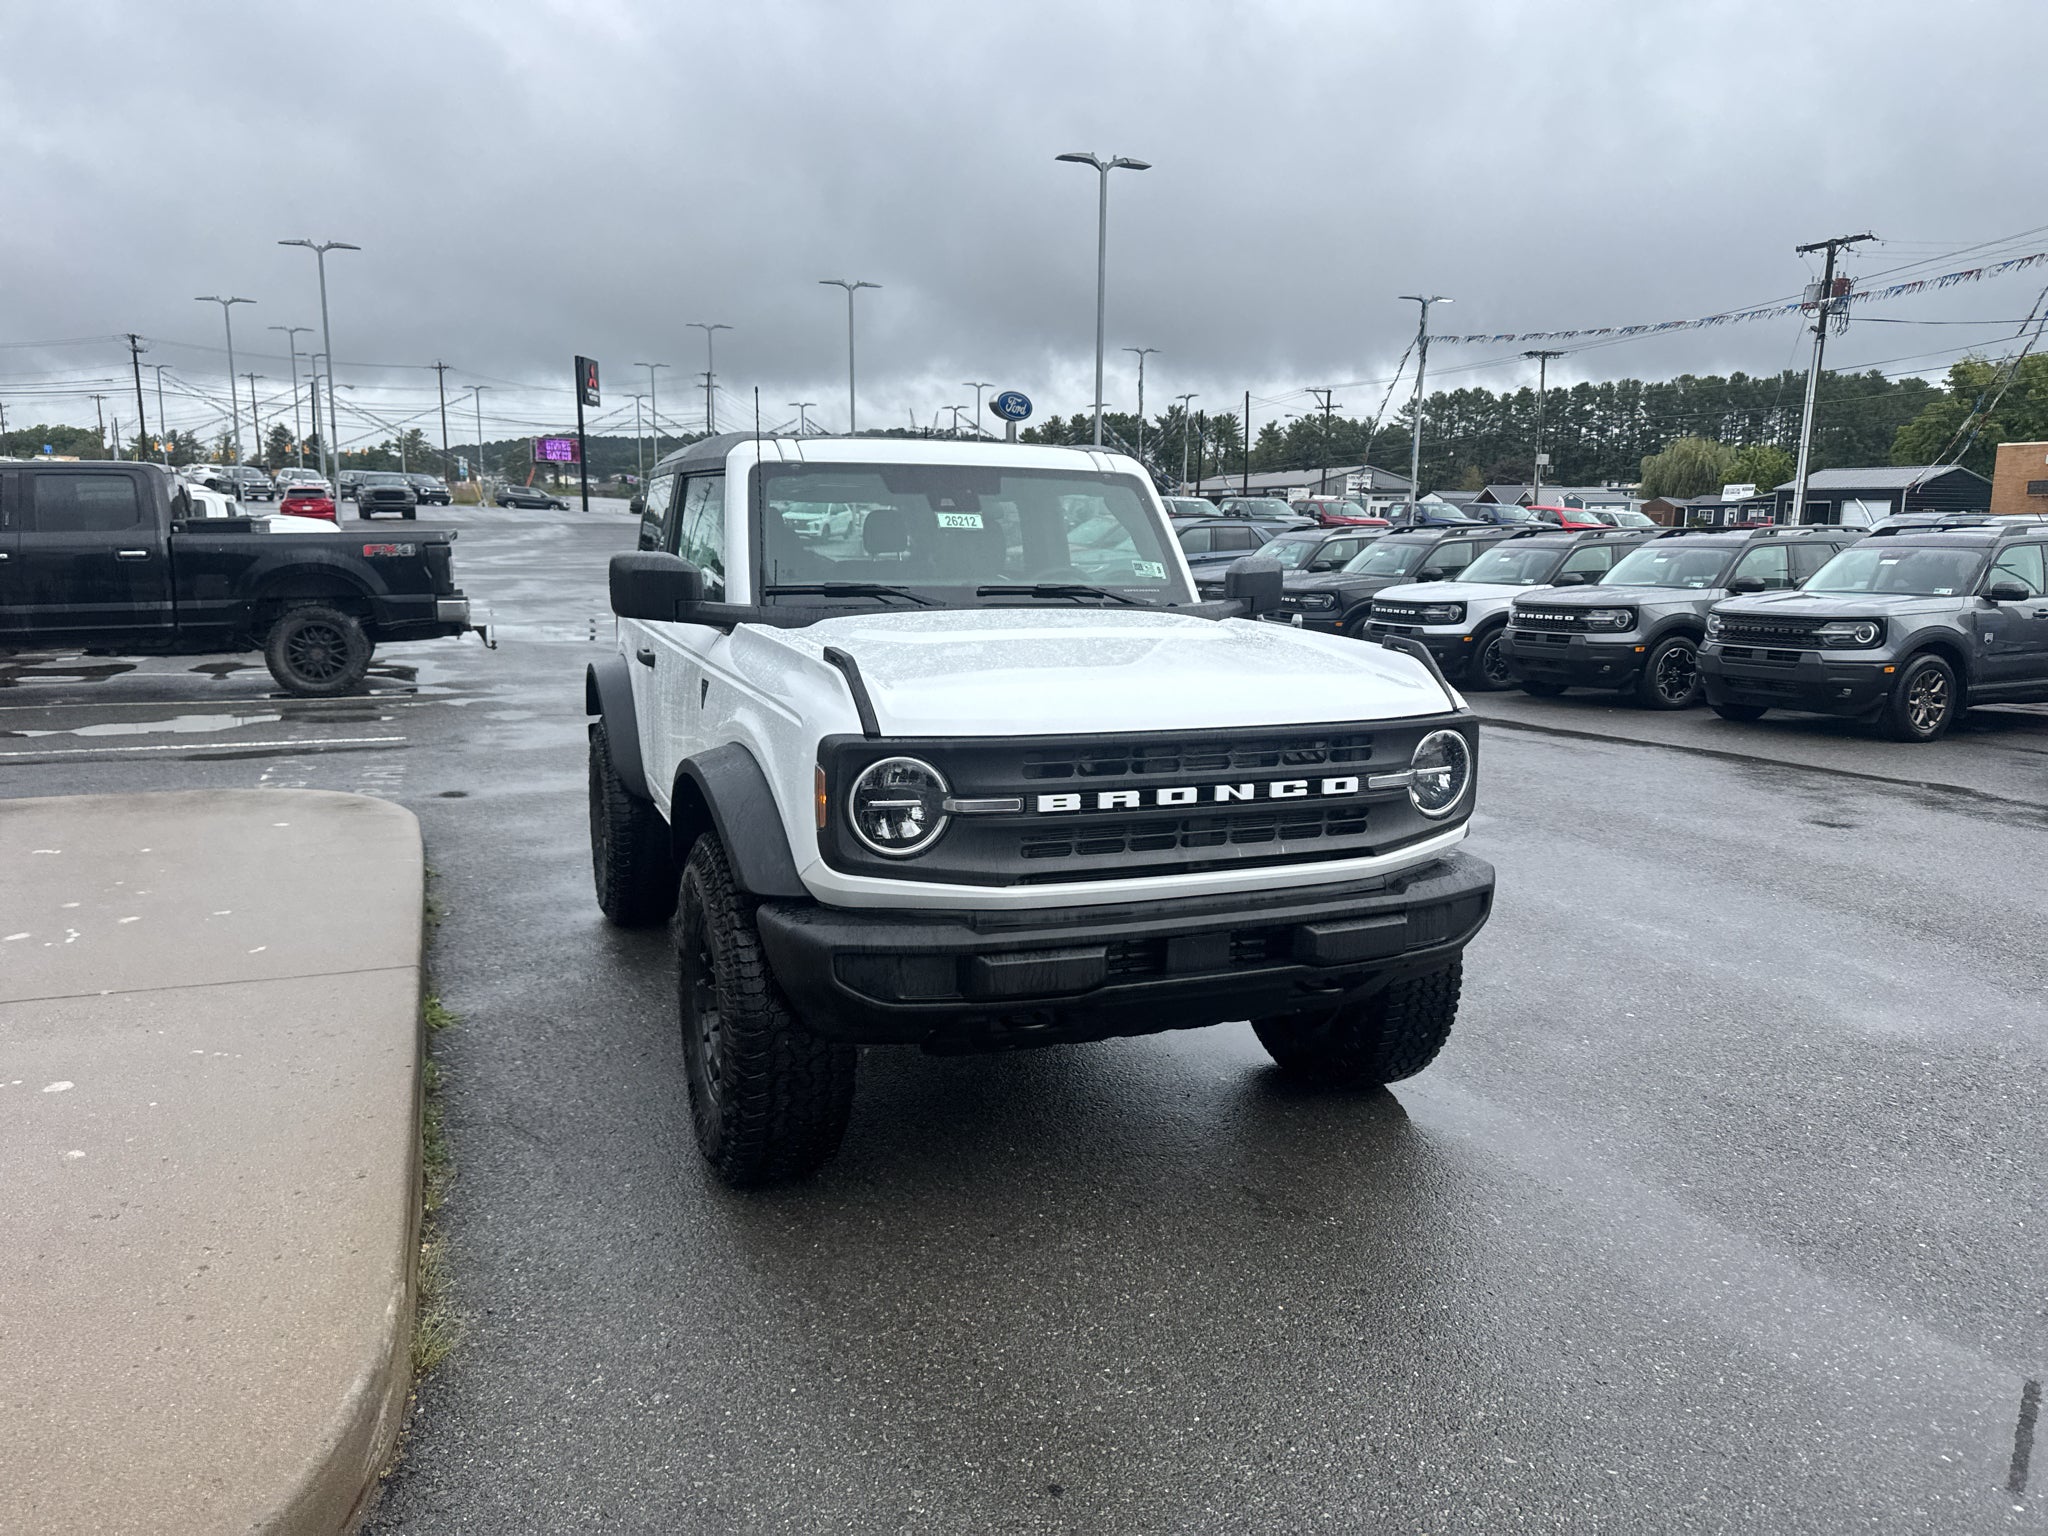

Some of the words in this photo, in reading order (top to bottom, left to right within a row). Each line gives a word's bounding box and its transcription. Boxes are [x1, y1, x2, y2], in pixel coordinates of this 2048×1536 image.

[1005, 396, 1027, 415] Ford
[945, 515, 977, 527] 26212
[363, 543, 416, 557] FX4
[1375, 607, 1416, 615] BRONCO
[1519, 613, 1575, 621] BRONCO
[1727, 625, 1805, 634] BRONCO
[1037, 776, 1359, 813] BRONCO
